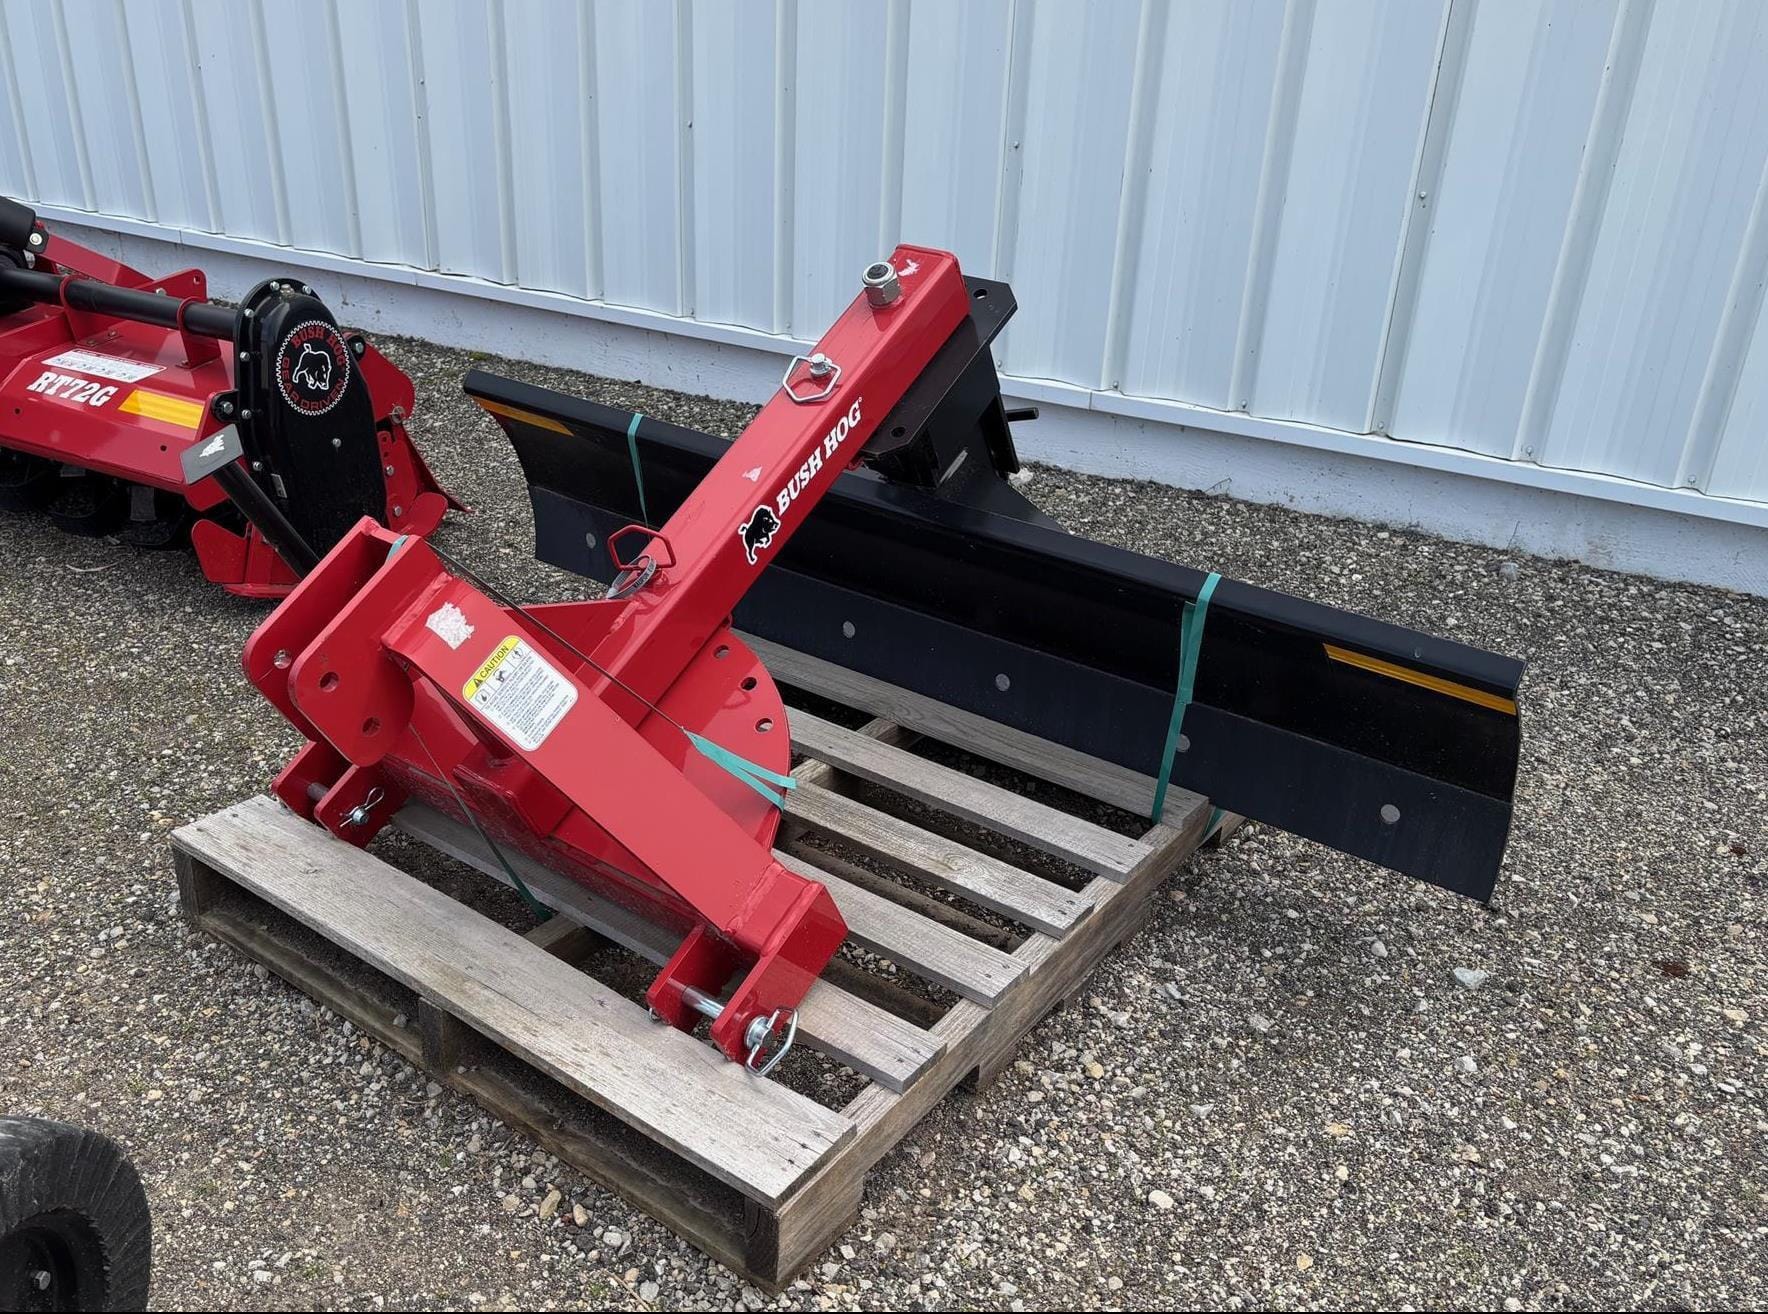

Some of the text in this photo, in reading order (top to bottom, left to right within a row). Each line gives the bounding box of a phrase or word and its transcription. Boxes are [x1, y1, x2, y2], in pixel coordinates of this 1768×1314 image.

[290, 326, 346, 367] BUSH HOG
[26, 371, 120, 407] RT72G
[281, 356, 345, 411] GEAR DRIVEN
[776, 400, 862, 516] BUSH HOG
[479, 645, 510, 679] CAUTION
